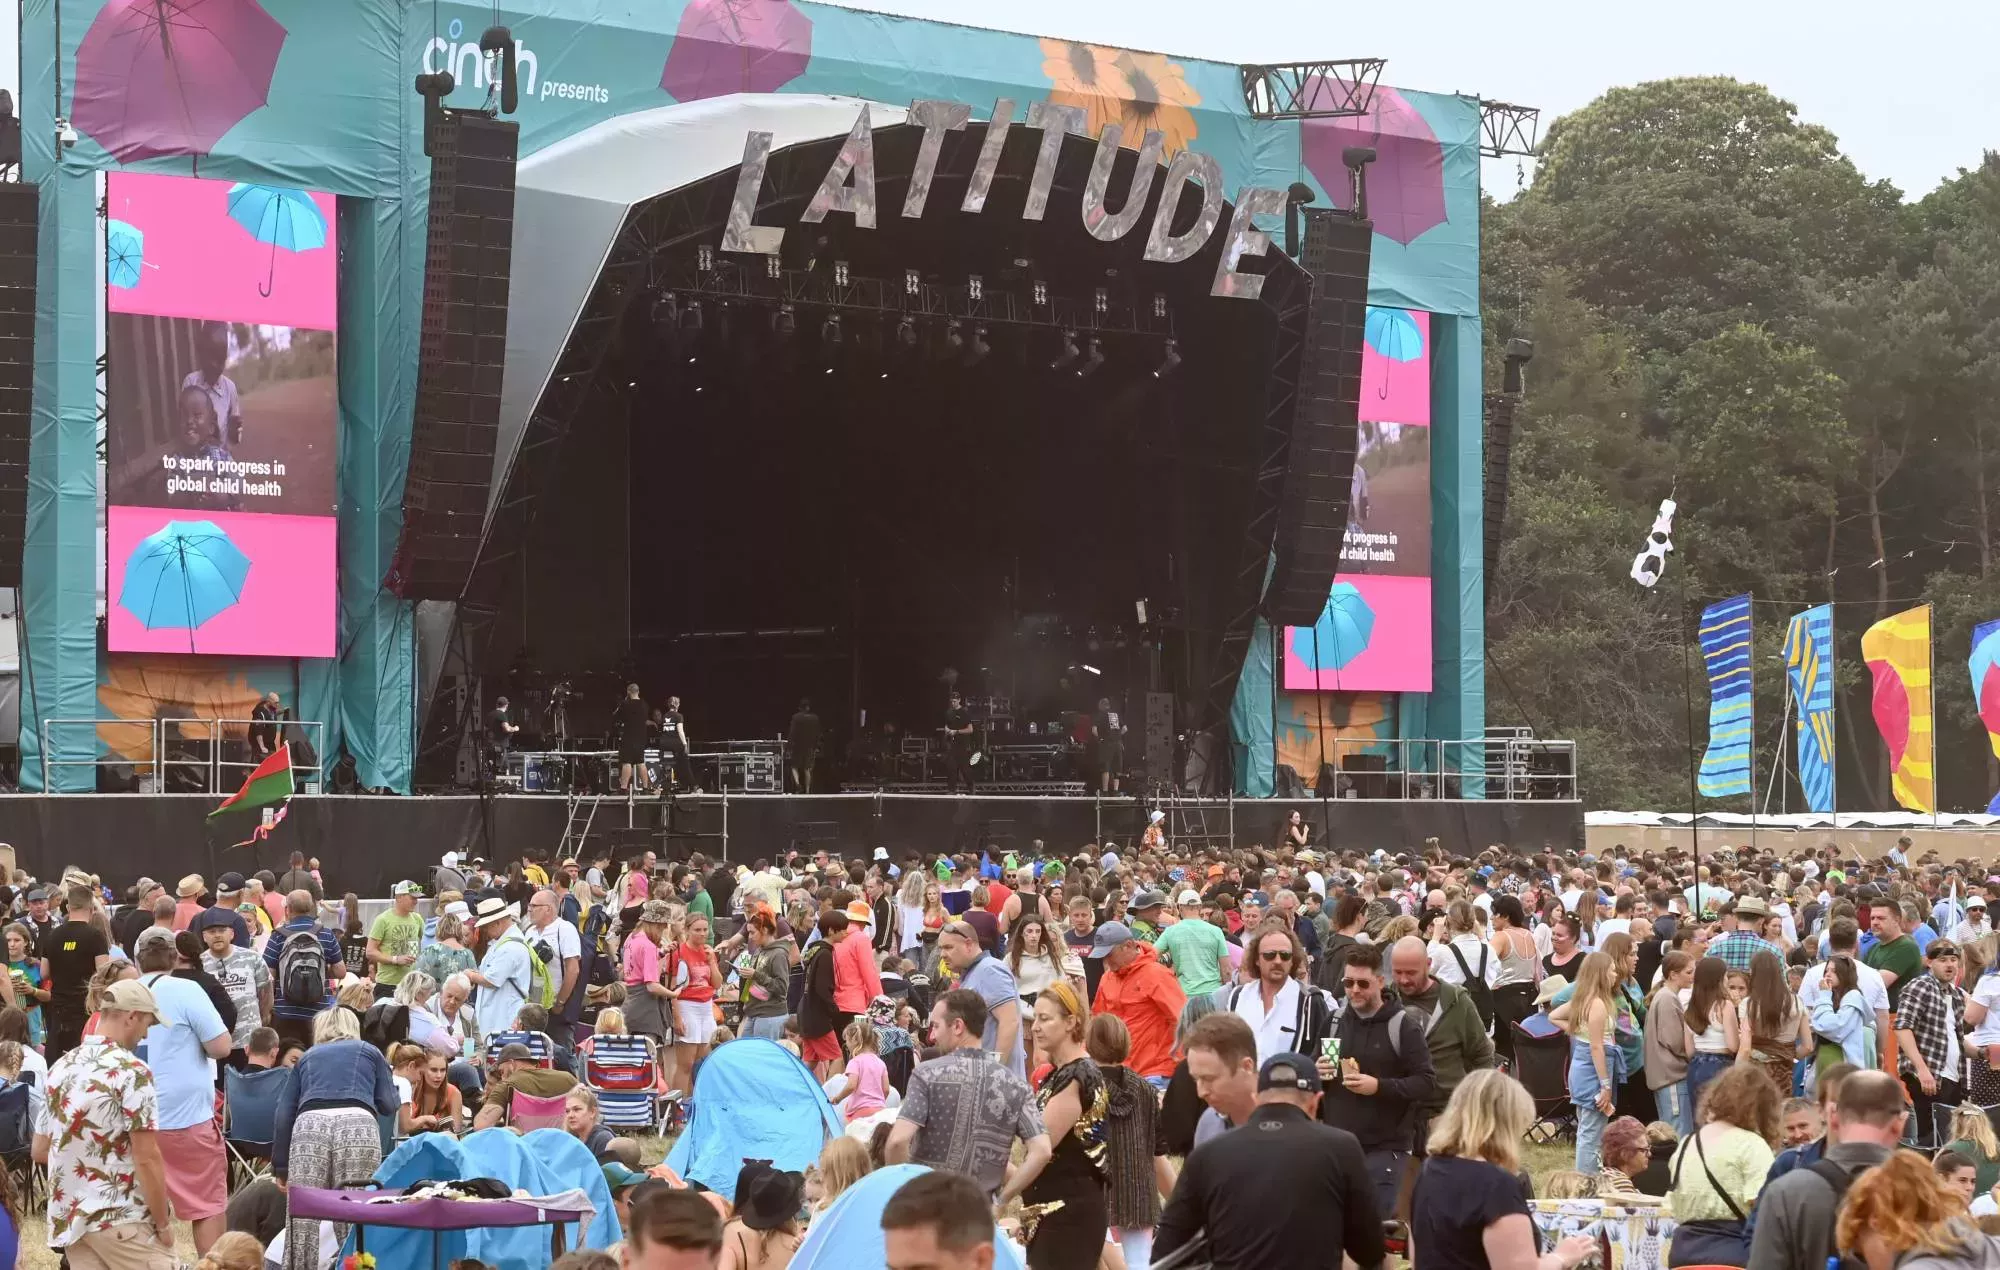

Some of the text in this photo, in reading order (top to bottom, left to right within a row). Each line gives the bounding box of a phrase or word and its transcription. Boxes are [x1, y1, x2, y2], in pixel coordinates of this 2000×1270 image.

[541, 80, 608, 103] presents
[720, 98, 1289, 299] LATITUDE
[163, 454, 286, 476] to spark progress in
[167, 475, 282, 496] global child health
[1353, 533, 1388, 546] progress
[1390, 532, 1397, 544] in
[1348, 546, 1368, 560] child
[1370, 548, 1395, 561] health
